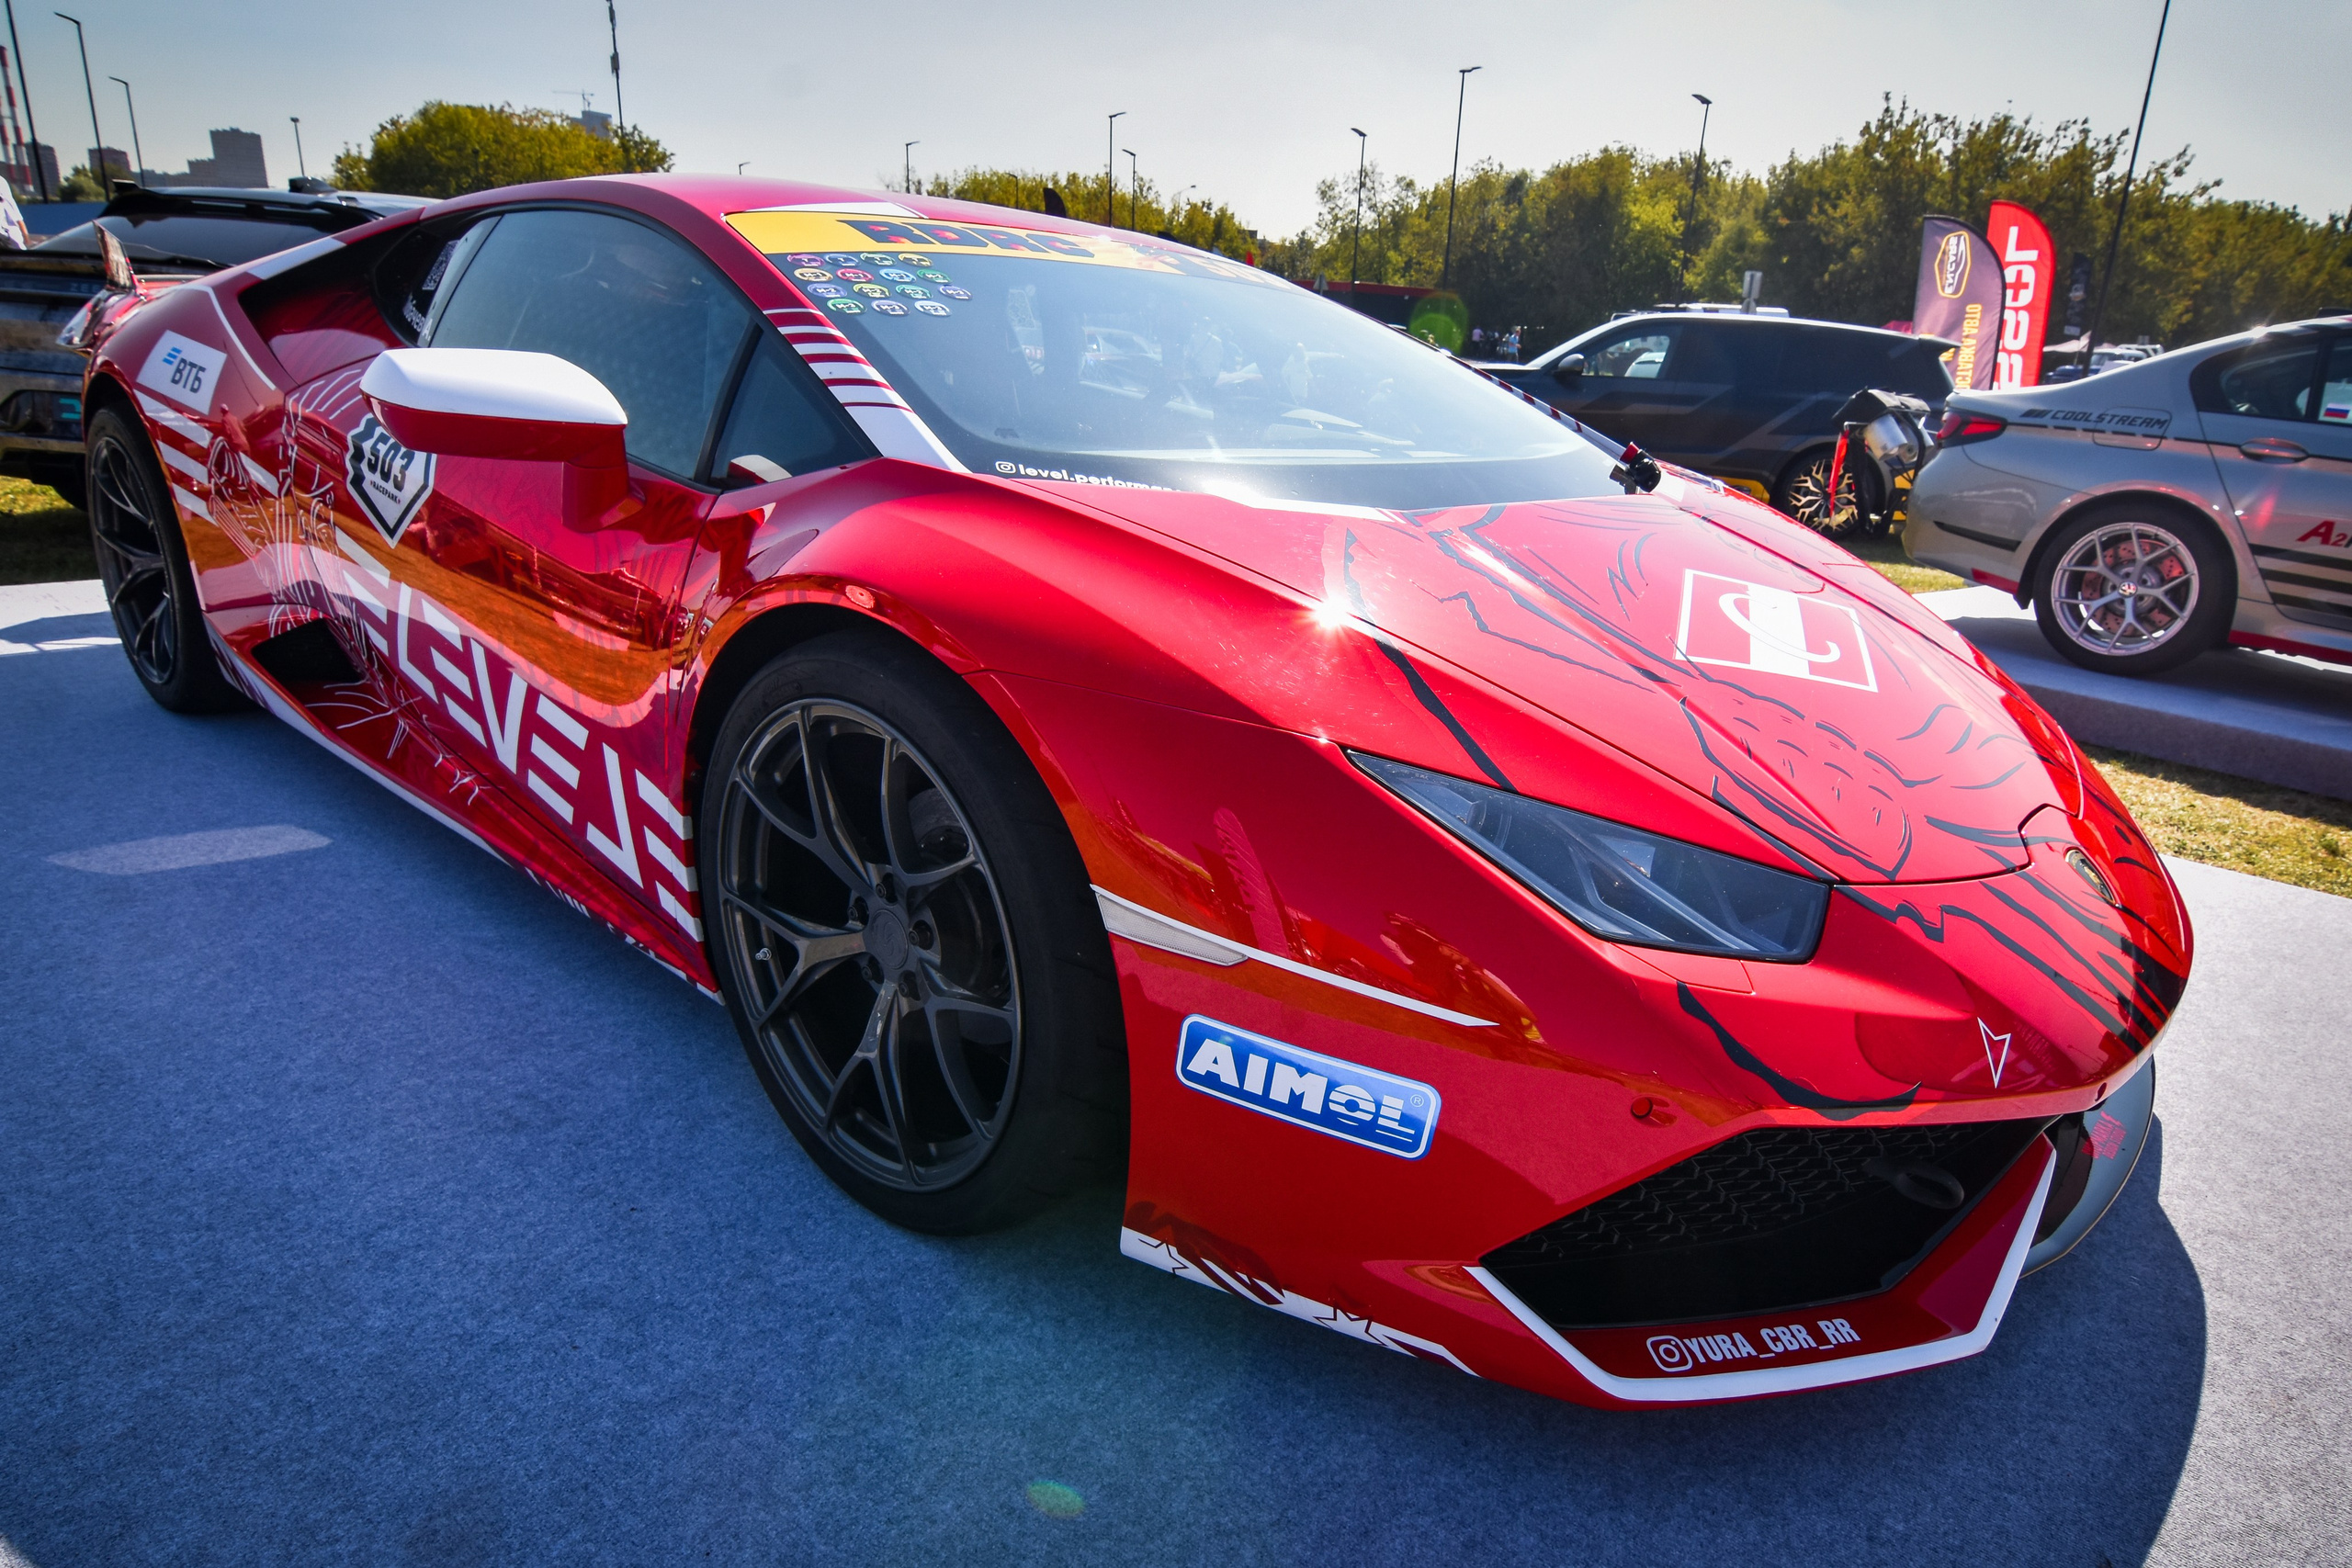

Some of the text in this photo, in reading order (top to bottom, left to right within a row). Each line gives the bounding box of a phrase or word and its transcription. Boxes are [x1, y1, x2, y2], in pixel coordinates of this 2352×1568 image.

[170, 357, 207, 394] ВТБ
[2051, 410, 2168, 430] COOLSTREAM
[368, 432, 416, 492] 503
[372, 480, 398, 504] RACEPARK
[1683, 1318, 1861, 1363] YURA_CBR_RR
